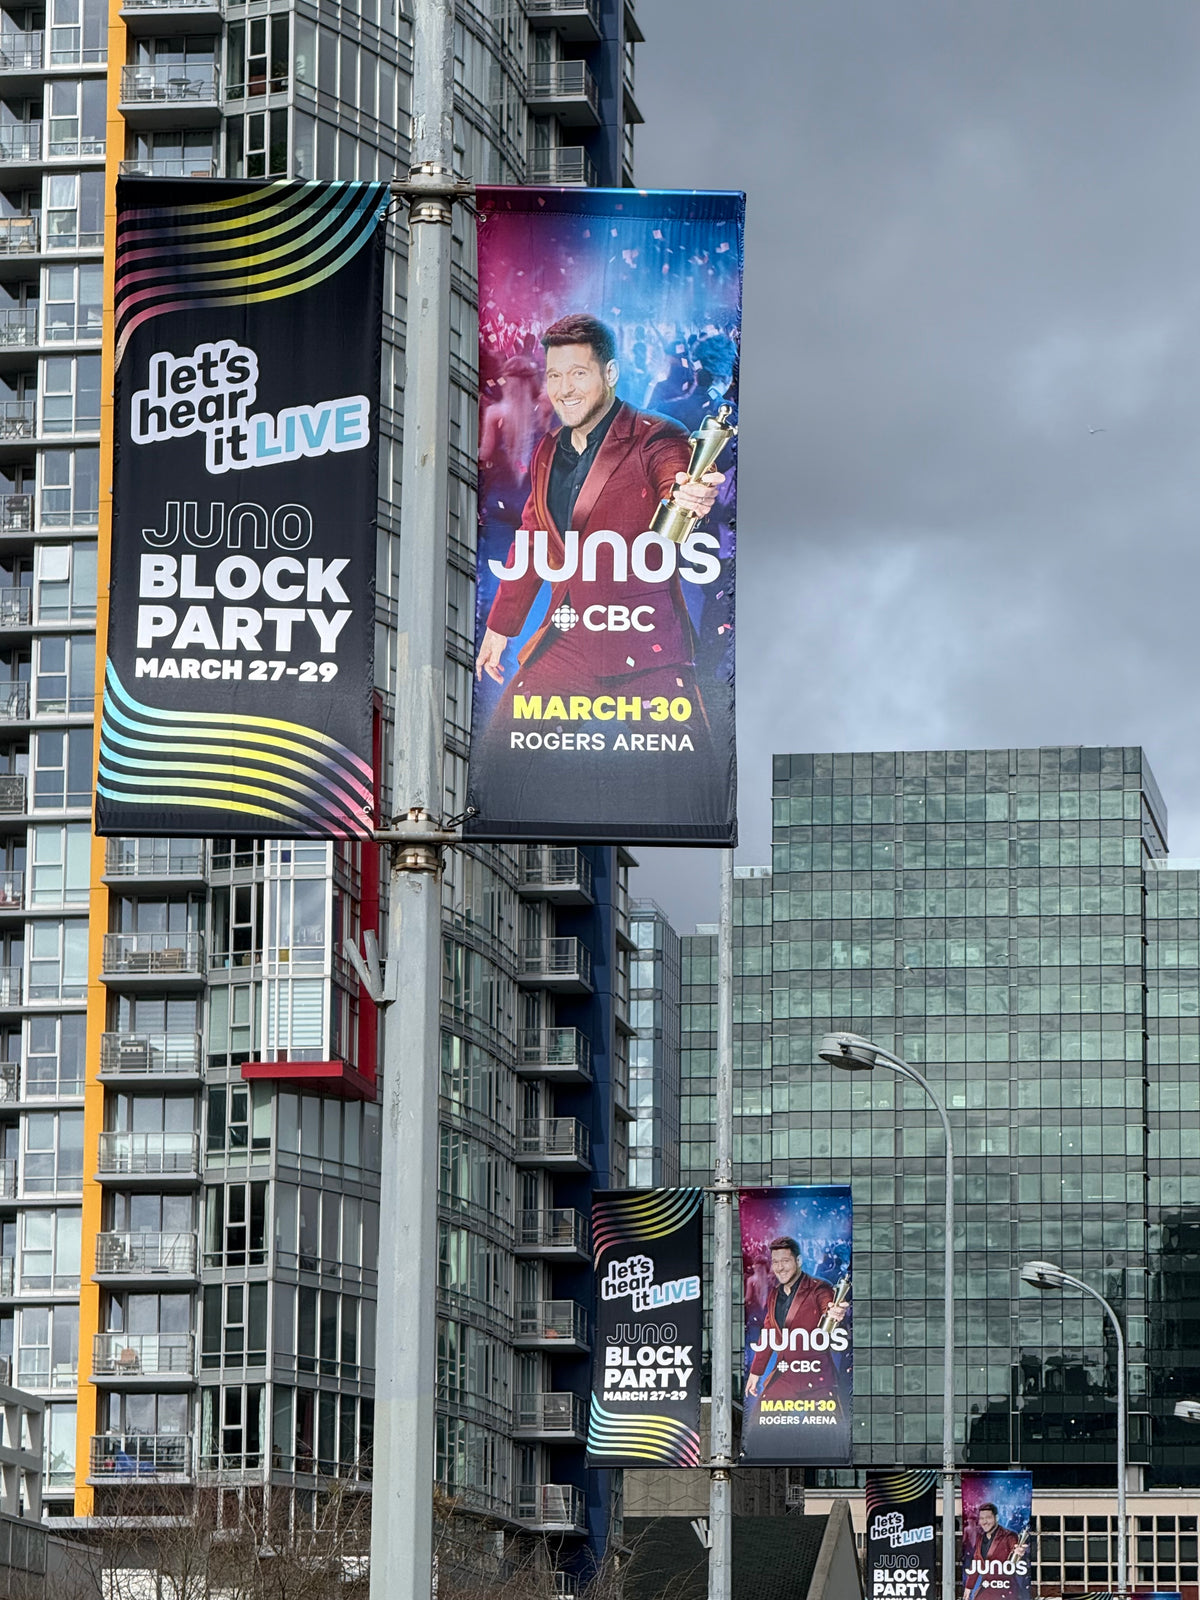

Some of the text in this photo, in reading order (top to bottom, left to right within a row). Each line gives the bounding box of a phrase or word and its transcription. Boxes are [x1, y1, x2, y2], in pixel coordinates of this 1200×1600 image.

[156, 347, 250, 398] let's
[138, 388, 248, 436] hear
[213, 403, 362, 466] it LIVE
[138, 553, 351, 603] BLOCK
[136, 604, 353, 653] PARTY
[582, 604, 656, 632] CBC
[135, 657, 338, 683] MARCH 27-29
[513, 694, 692, 721] MARCH 30
[510, 731, 695, 752] ROGERS ARENA
[612, 1258, 651, 1281] let's
[605, 1275, 650, 1297] hear
[636, 1279, 697, 1309] it LIVE
[605, 1345, 693, 1367] BLOCK
[790, 1360, 821, 1373] CBC
[603, 1367, 694, 1389] PARTY
[603, 1390, 688, 1401] MARCH 27-29
[760, 1400, 836, 1412] MARCH 30
[759, 1416, 837, 1425] ROGERS ARENA
[872, 1525, 901, 1538] hear
[877, 1514, 902, 1528] let's
[903, 1527, 932, 1543] LIVE
[873, 1569, 930, 1582] BLOCK
[990, 1580, 1010, 1589] CBC
[873, 1583, 930, 1596] PARTY
